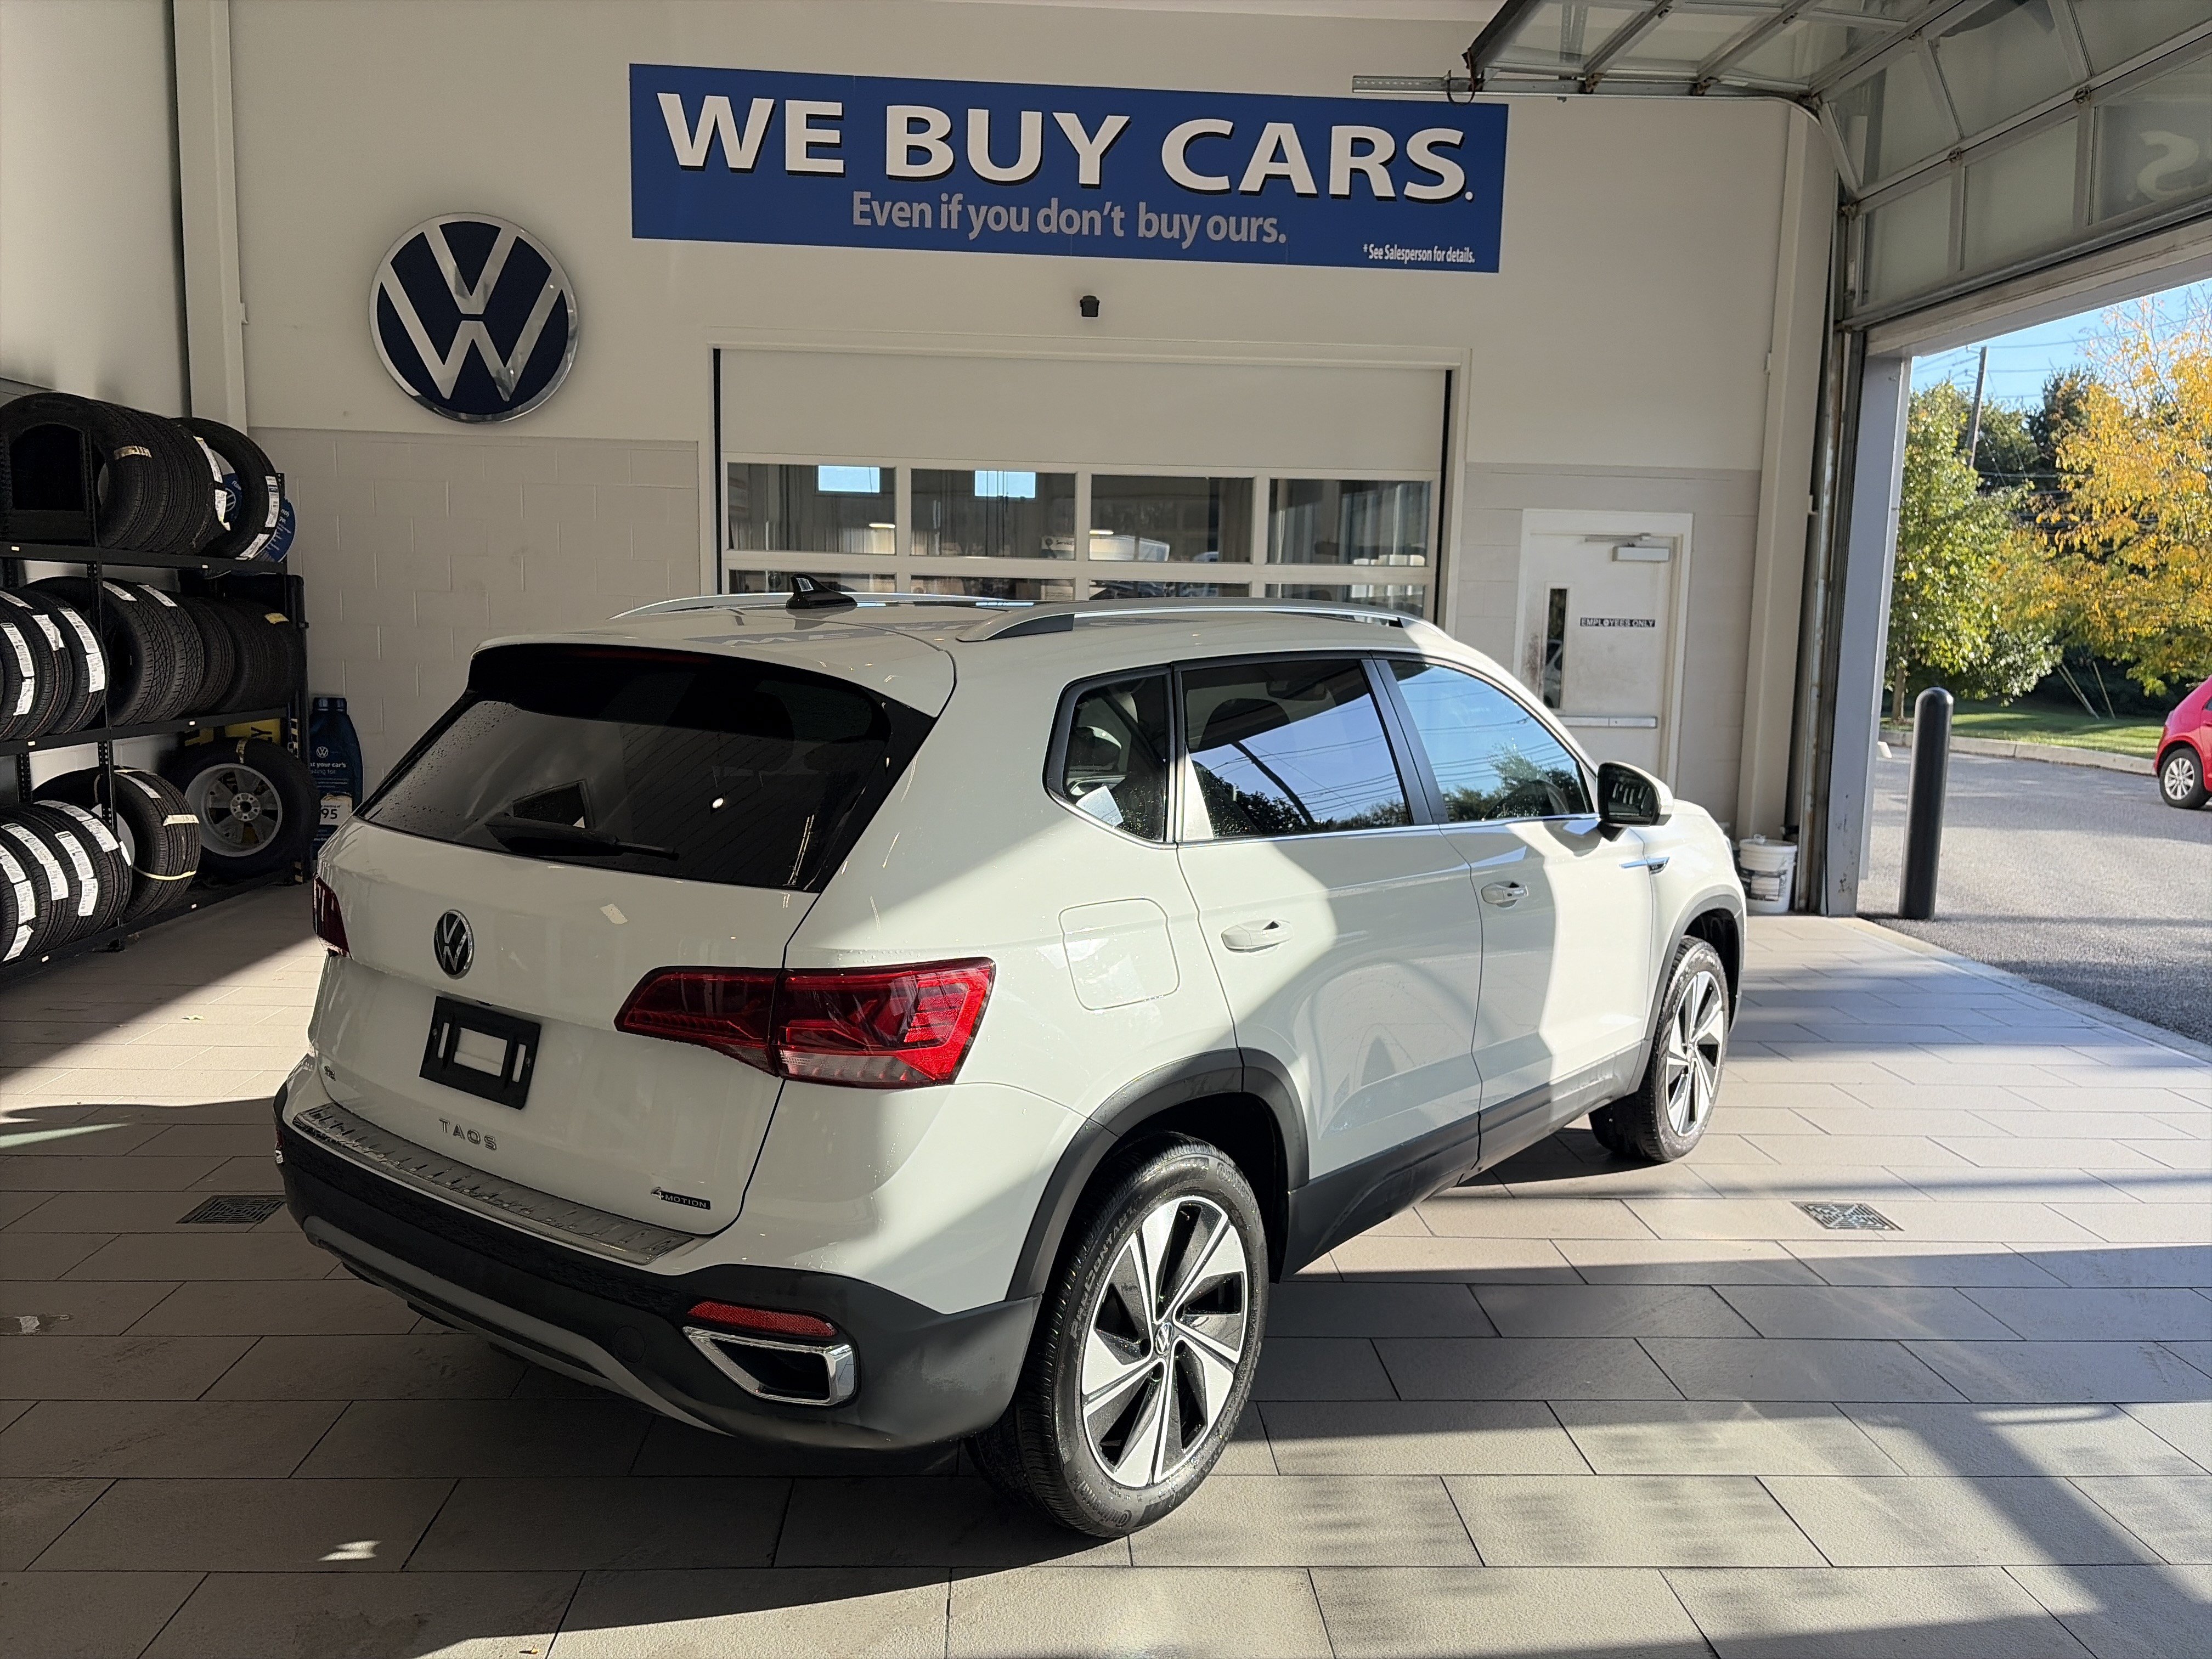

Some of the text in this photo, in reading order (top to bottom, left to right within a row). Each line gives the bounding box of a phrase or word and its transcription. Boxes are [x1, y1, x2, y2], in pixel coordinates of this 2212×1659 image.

[657, 92, 1474, 204] WE BUY CARS.
[853, 191, 932, 228] Even
[940, 193, 963, 229] if
[967, 204, 1029, 240] you
[1137, 201, 1201, 250] buy
[1207, 215, 1286, 244] ours.
[1384, 244, 1432, 264] Salesperson
[1433, 245, 1446, 262] for
[1446, 246, 1475, 263] details.
[1581, 618, 1655, 628] EMPLOYEES ONLY
[439, 1118, 496, 1150] TAOS
